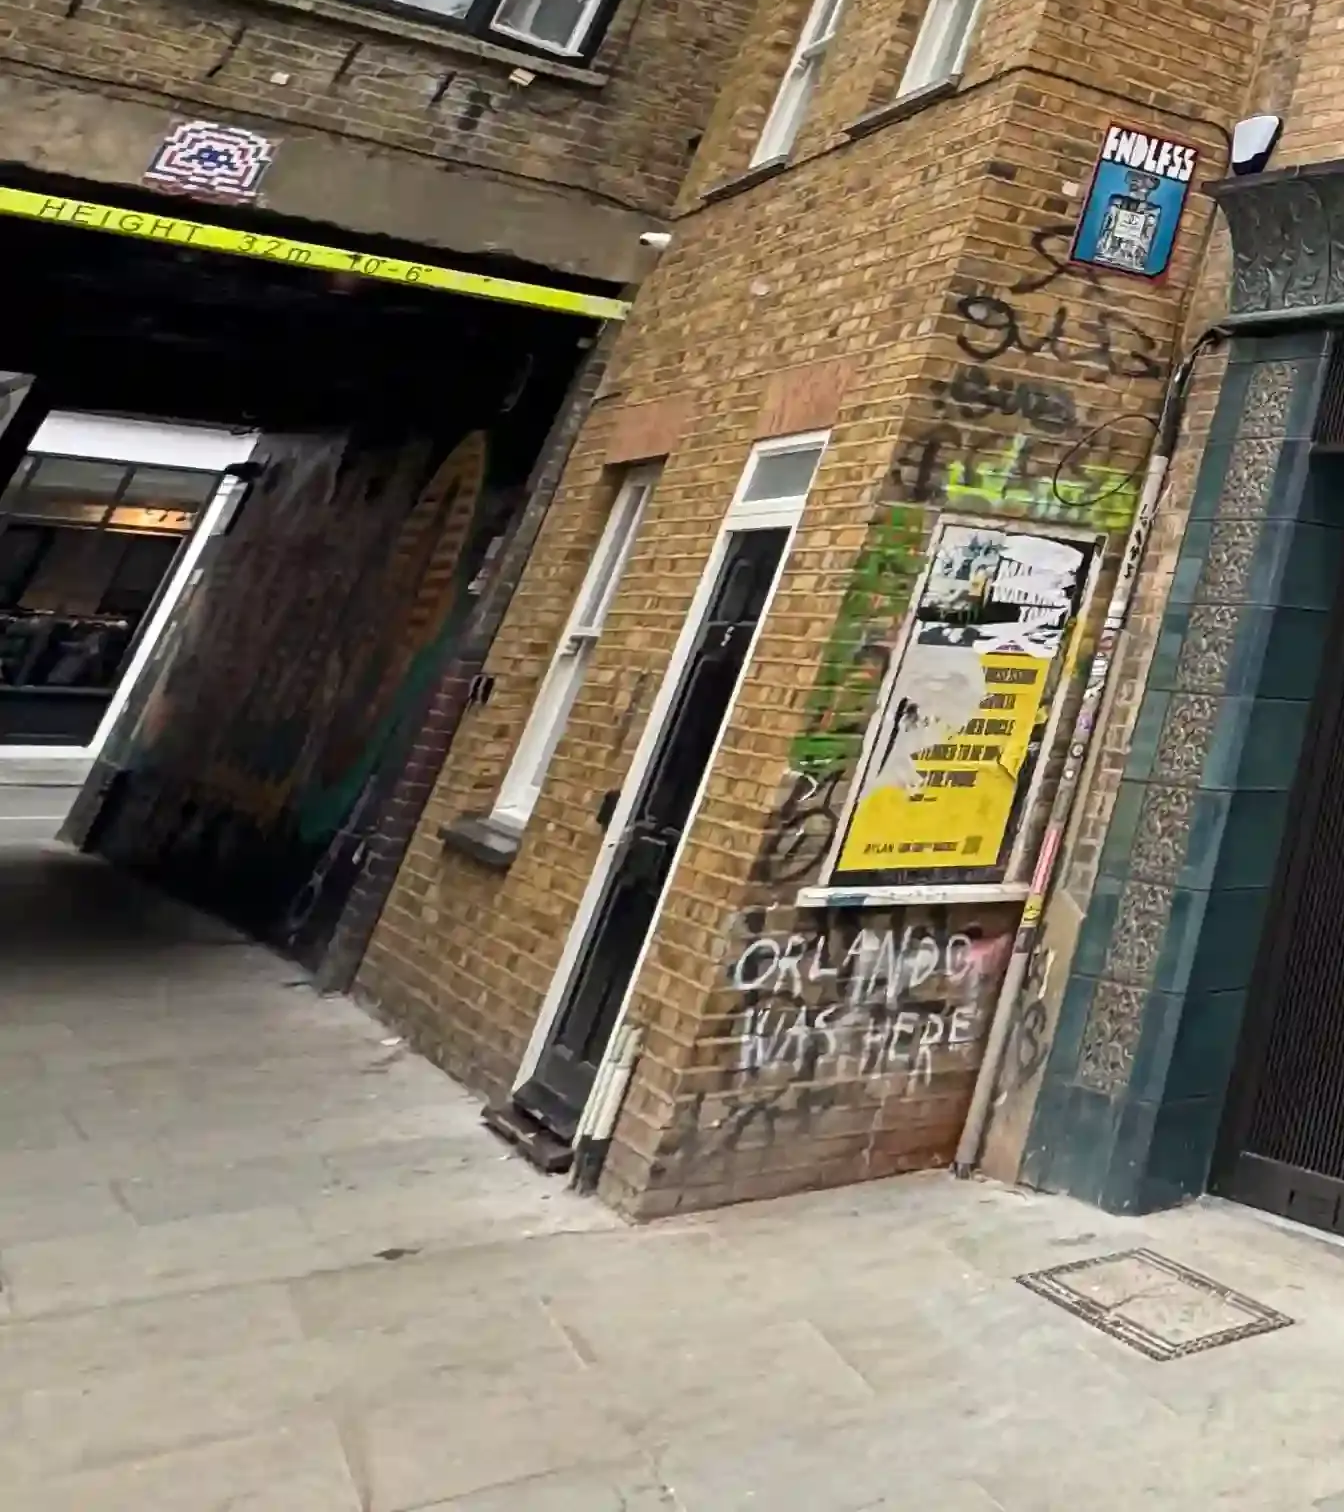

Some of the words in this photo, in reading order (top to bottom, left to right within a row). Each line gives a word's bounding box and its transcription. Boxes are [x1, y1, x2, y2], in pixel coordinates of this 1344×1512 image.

[1101, 125, 1198, 182] ENDLESS
[38, 197, 205, 244] HEIGHT
[733, 925, 972, 1004] ORLANDO
[740, 1004, 838, 1071] WAS
[858, 1003, 978, 1088] HERE
